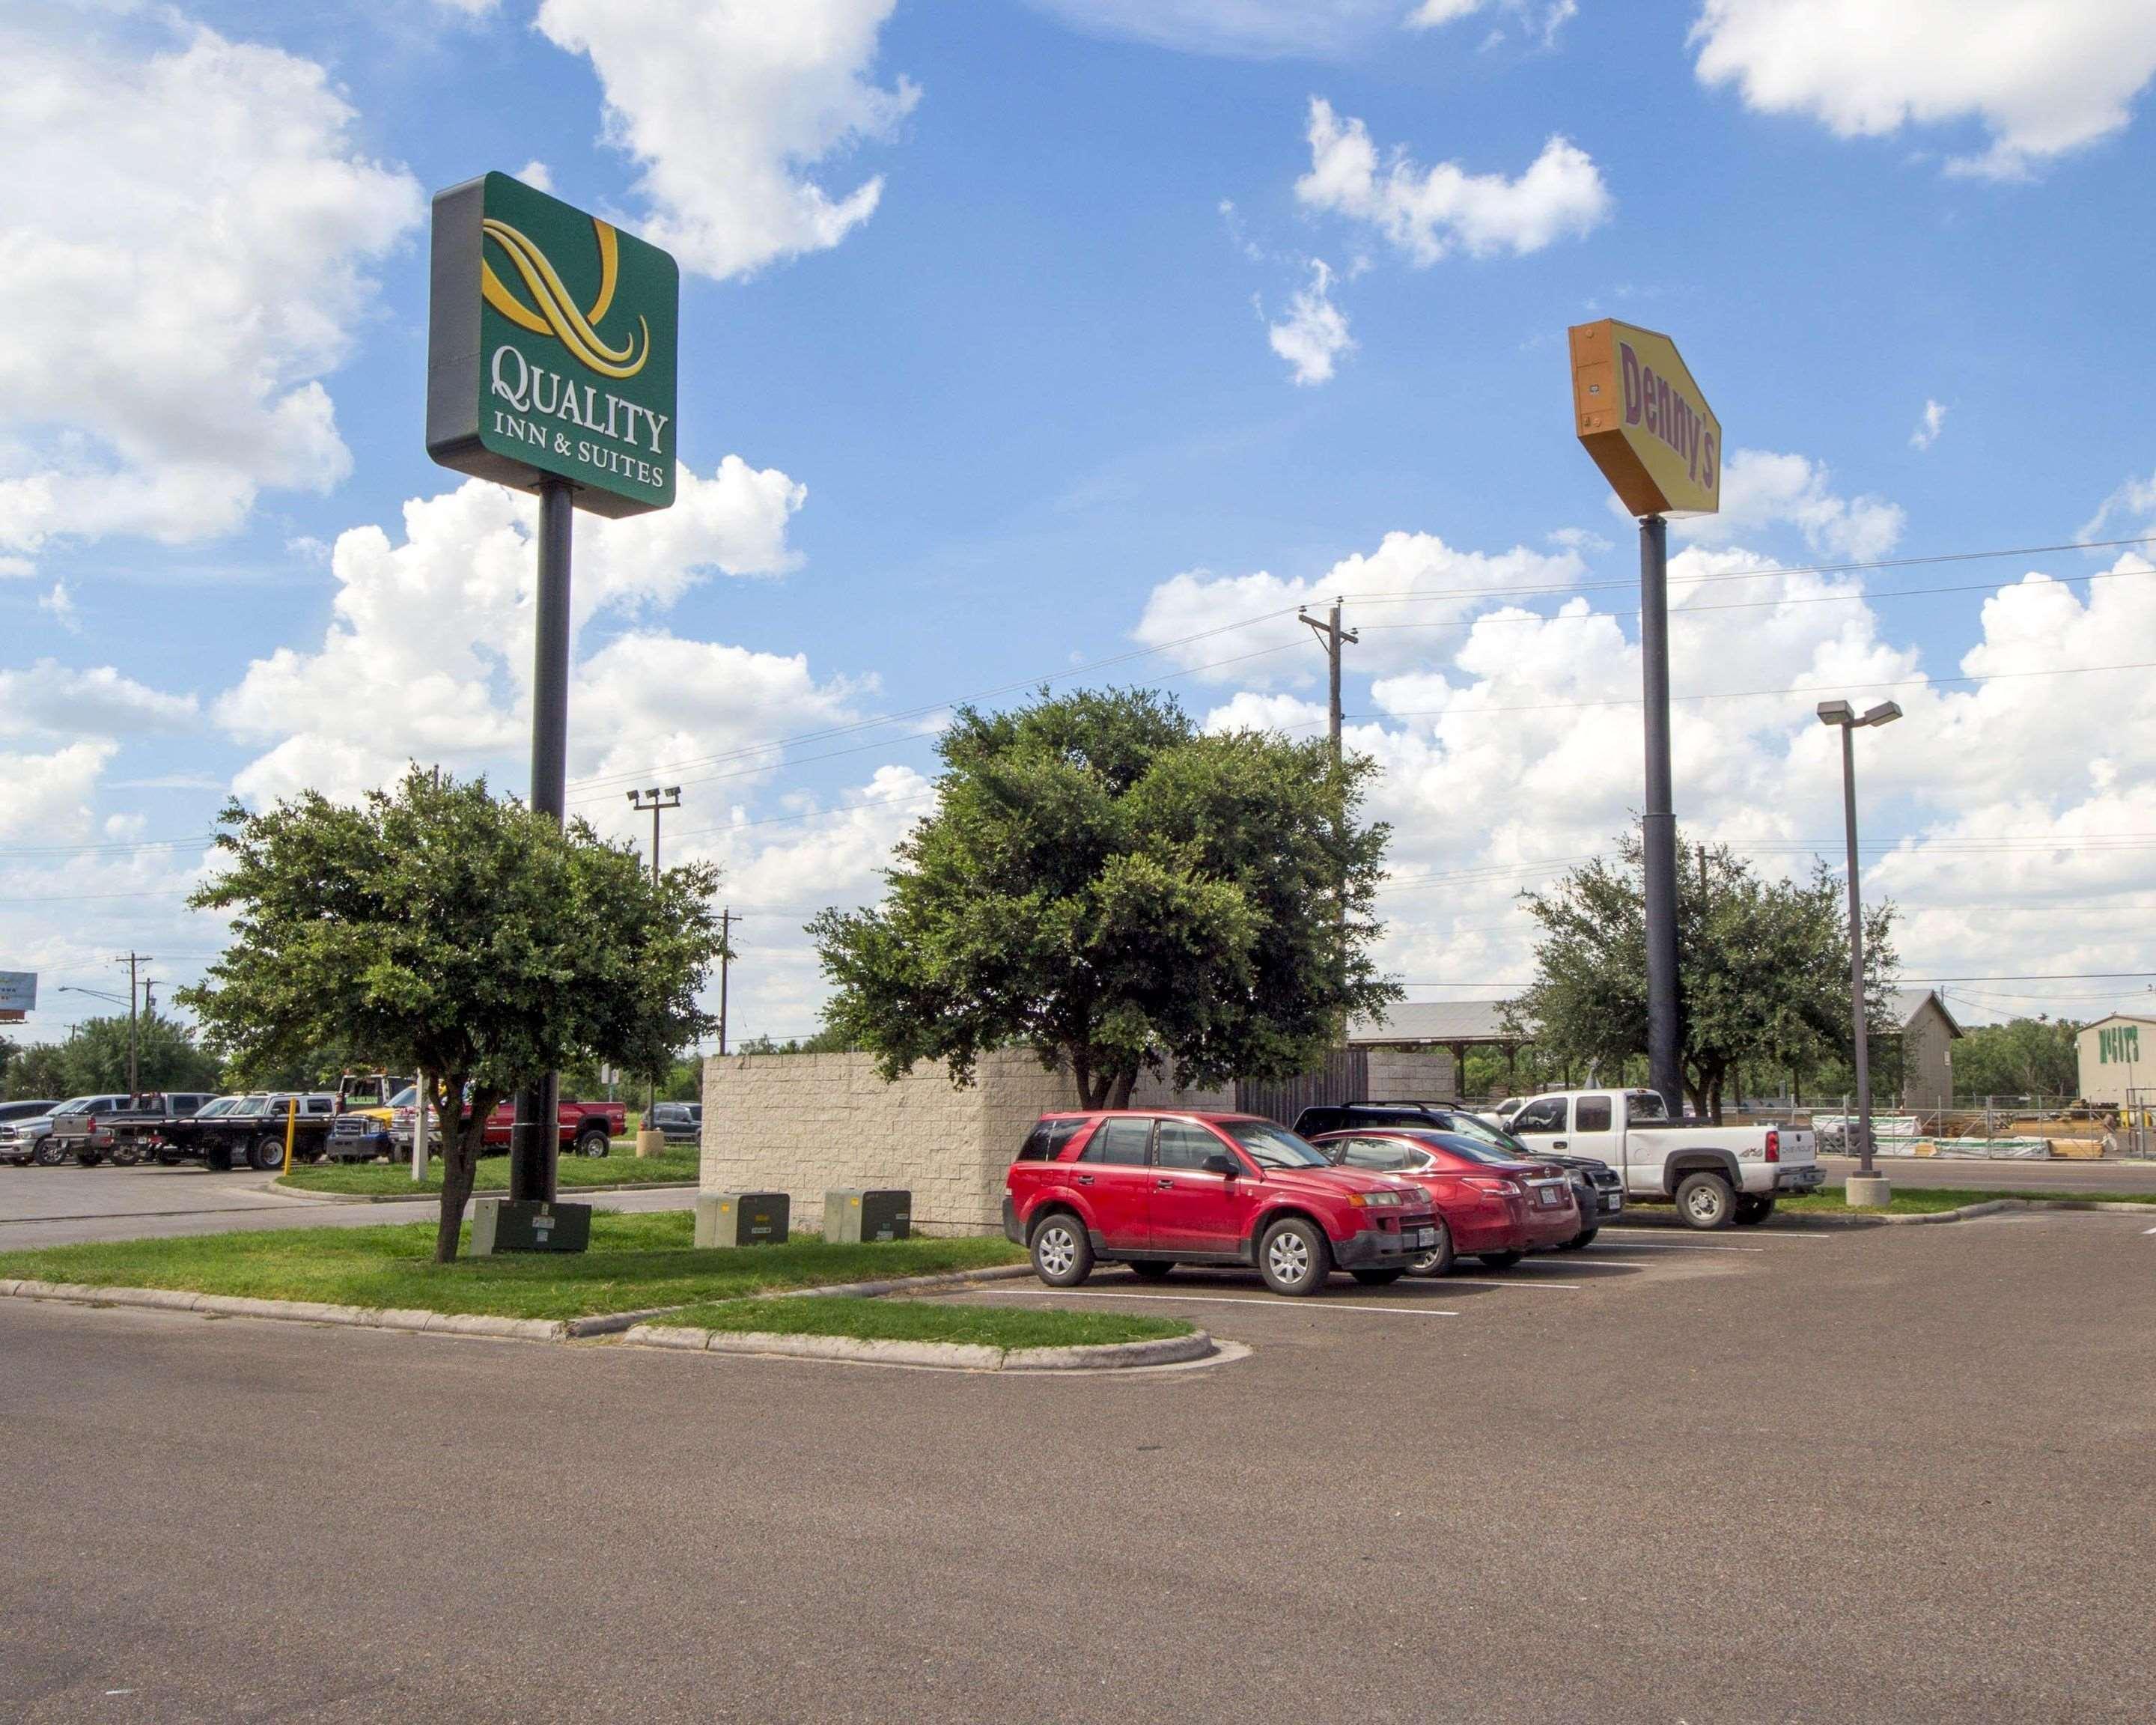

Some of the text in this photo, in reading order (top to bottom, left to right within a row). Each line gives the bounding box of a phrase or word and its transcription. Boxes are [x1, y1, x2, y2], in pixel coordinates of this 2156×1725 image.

[491, 345, 669, 454] QUALITY
[493, 410, 664, 487] INN & SUITES
[1619, 341, 1714, 490] Denny's
